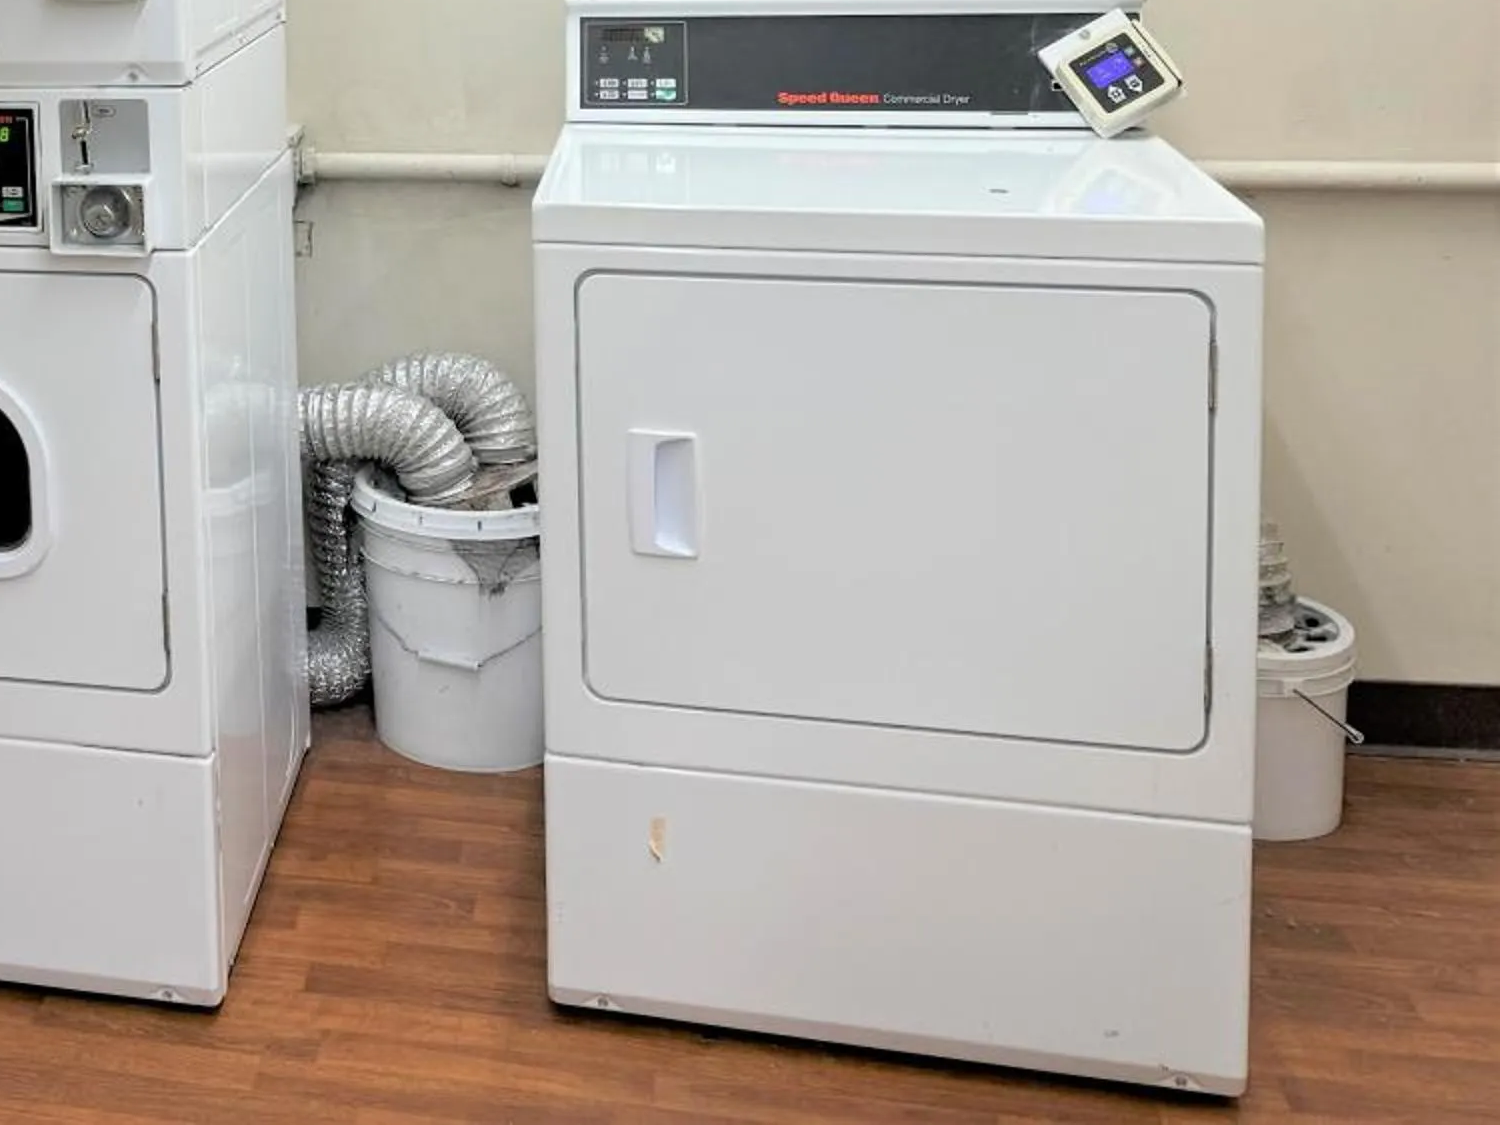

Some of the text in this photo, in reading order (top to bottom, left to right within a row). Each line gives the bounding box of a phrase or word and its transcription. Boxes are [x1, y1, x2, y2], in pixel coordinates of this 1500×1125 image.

[778, 91, 971, 105] Speed Queen Commercial Dryer
